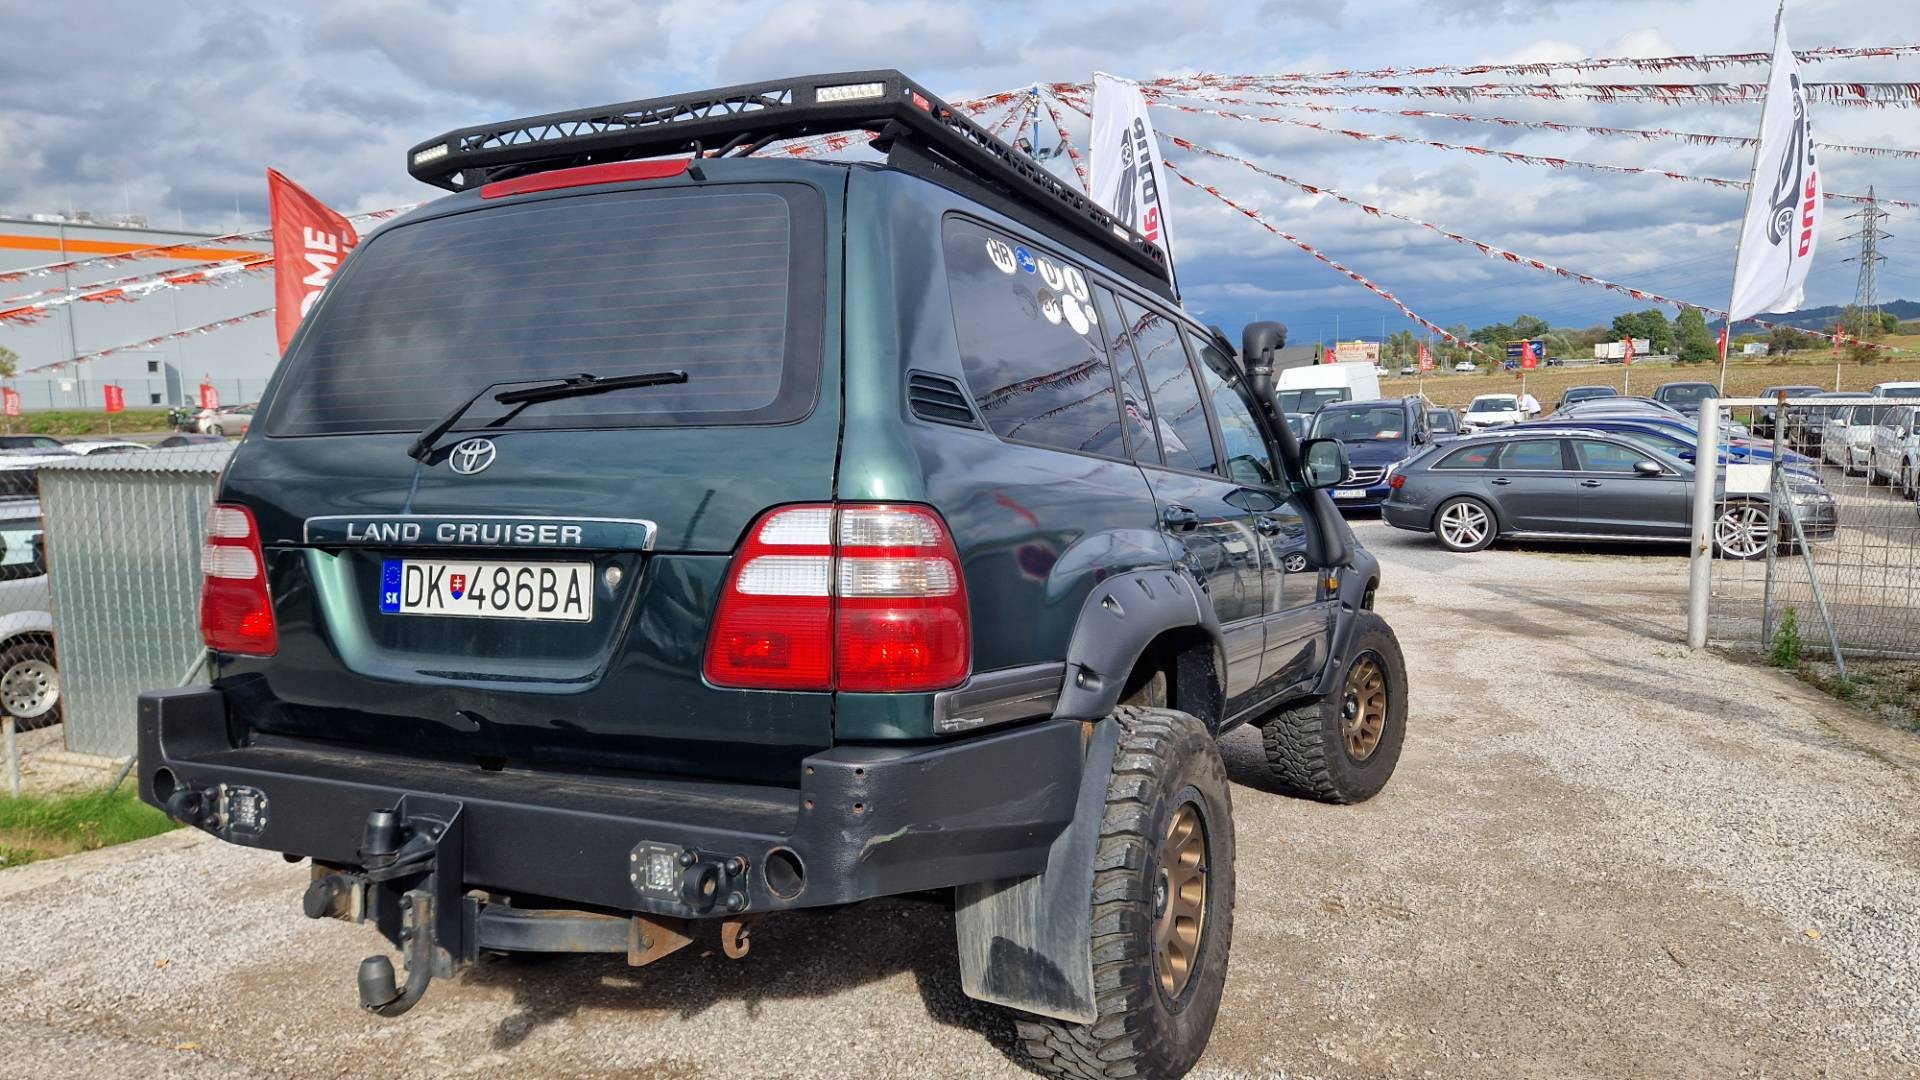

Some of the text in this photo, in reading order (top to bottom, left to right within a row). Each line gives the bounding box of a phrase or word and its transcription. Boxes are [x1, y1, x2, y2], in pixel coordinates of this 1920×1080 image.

[987, 239, 1013, 268] HR
[1070, 271, 1084, 297] A
[346, 523, 583, 545] LAND CRUISER
[385, 592, 399, 604] SK
[404, 565, 583, 614] DK 486BA
